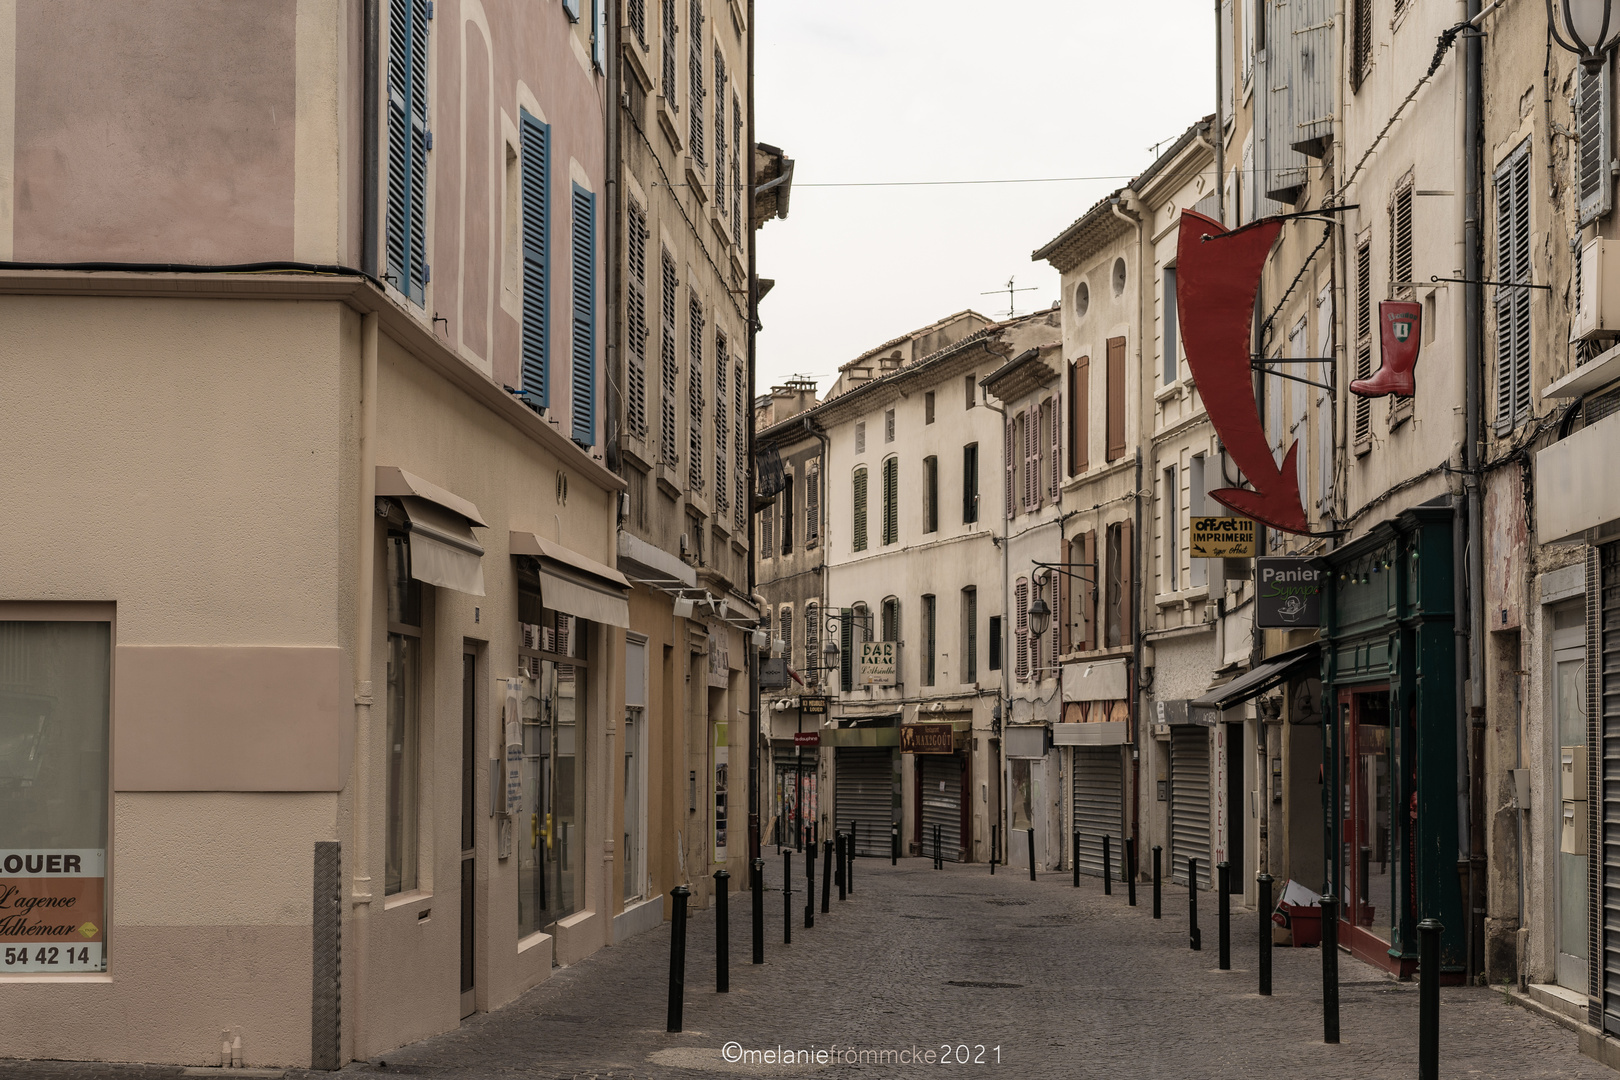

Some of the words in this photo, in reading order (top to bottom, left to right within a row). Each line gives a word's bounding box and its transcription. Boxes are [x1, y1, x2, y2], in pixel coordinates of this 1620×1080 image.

[1193, 533, 1253, 542] IMPRIMERIE
[1262, 567, 1321, 583] Panier
[863, 643, 893, 656] BAR
[860, 656, 896, 664] TABAC
[861, 665, 896, 675] L'Absinthe
[0, 854, 81, 873] OUER
[5, 947, 28, 965] 54
[35, 947, 59, 965] 42
[66, 947, 89, 965] 14
